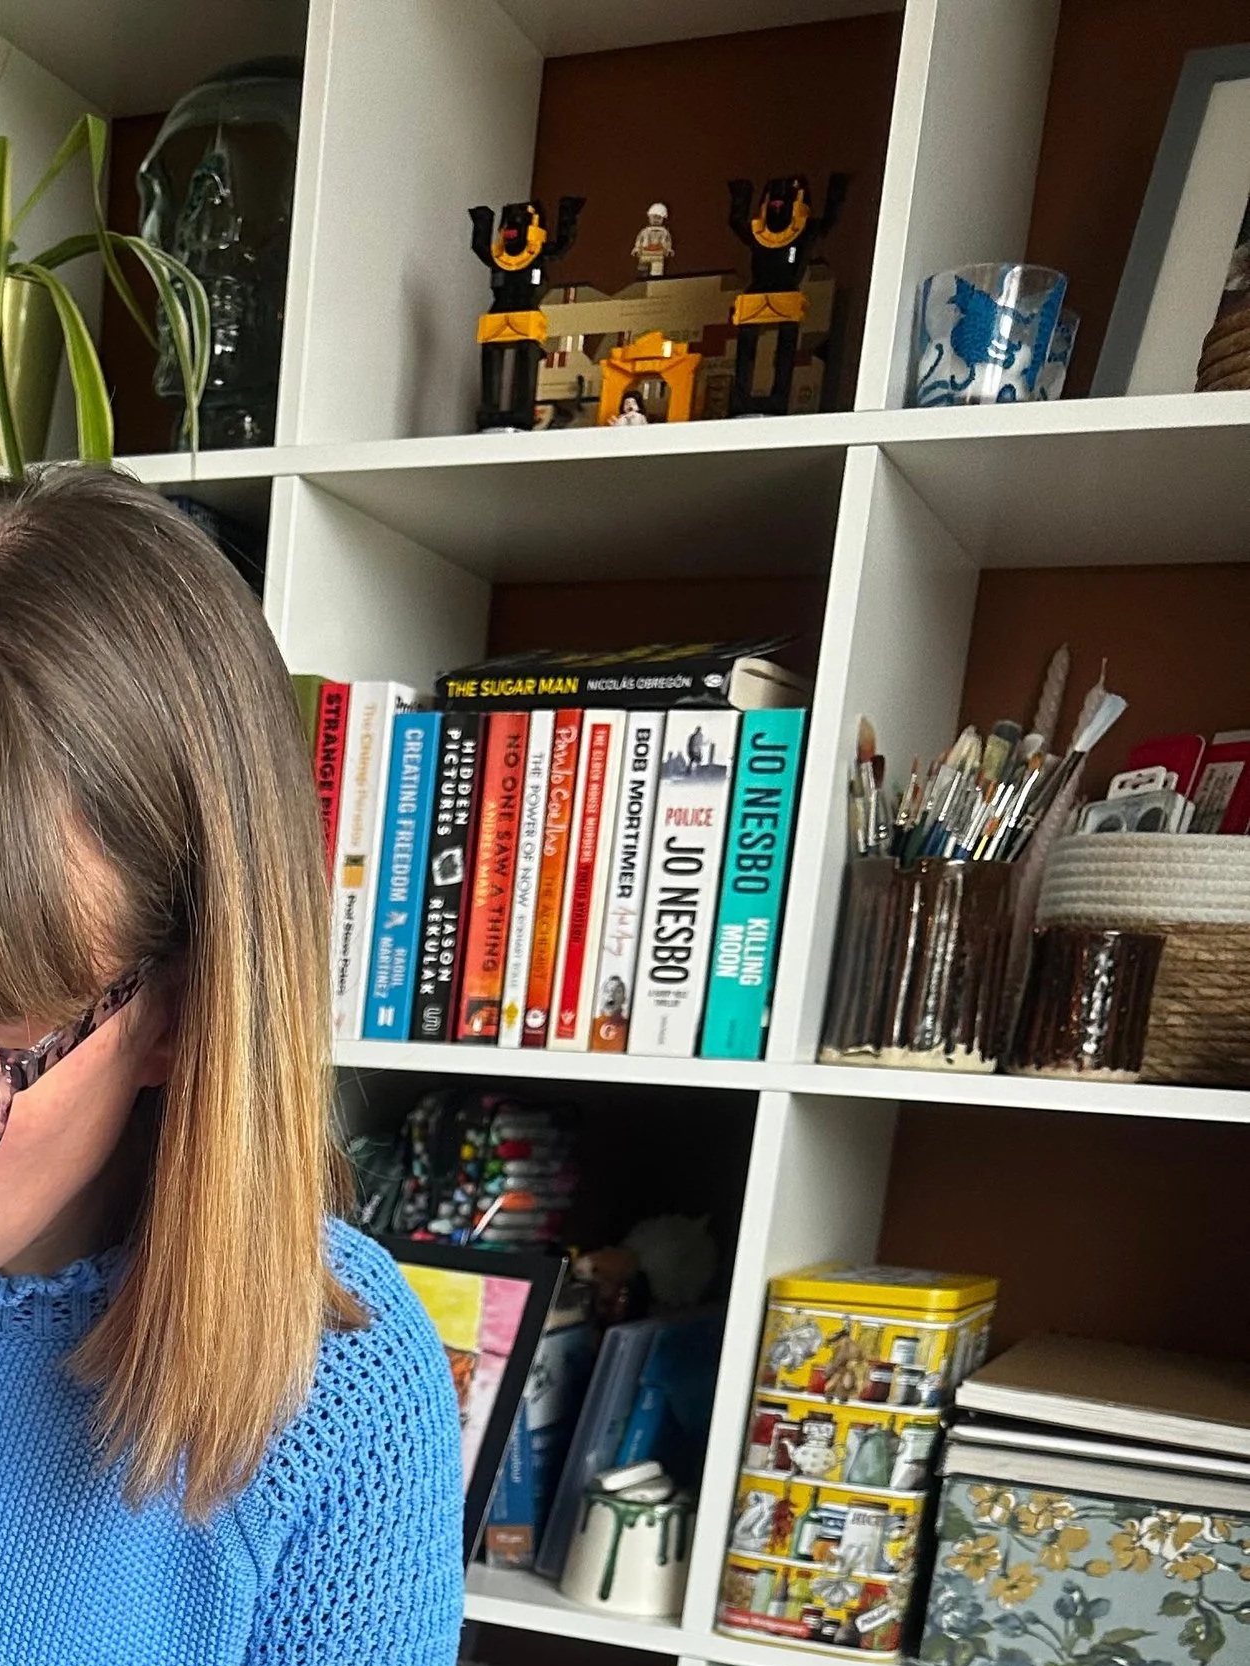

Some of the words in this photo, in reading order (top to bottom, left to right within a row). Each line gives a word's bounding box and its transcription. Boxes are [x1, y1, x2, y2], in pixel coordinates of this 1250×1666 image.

[446, 681, 478, 697] THE
[480, 679, 535, 696] SUGAR
[538, 676, 579, 694] MAN
[319, 693, 341, 790] STRANGE
[504, 734, 521, 768] NO
[530, 753, 543, 777] THE
[551, 726, 578, 785] Paulo
[593, 729, 607, 746] THE
[632, 728, 651, 772] BOB
[749, 732, 788, 775] JO
[398, 728, 425, 814] CREATING
[437, 727, 462, 836] PICTURES
[454, 739, 476, 825] HIDDEN
[500, 776, 517, 819] ONE
[524, 785, 540, 837] POWER
[543, 788, 570, 857] Coelho
[665, 807, 714, 827] POLICE
[389, 819, 416, 902] FREEDOM
[494, 829, 512, 876] SAW
[521, 842, 535, 862] OF
[617, 780, 646, 899] MORTIMER
[662, 836, 705, 876] JO
[732, 788, 783, 894] NESBO
[492, 883, 505, 896] A
[517, 867, 533, 907] NOW
[419, 895, 444, 995] REKULAK
[437, 910, 459, 982] JASON
[482, 907, 504, 972] THING
[648, 887, 700, 985] NESBO
[715, 924, 745, 978] MOON
[738, 917, 770, 987] KILLING
[373, 936, 394, 999] MARTINEZ
